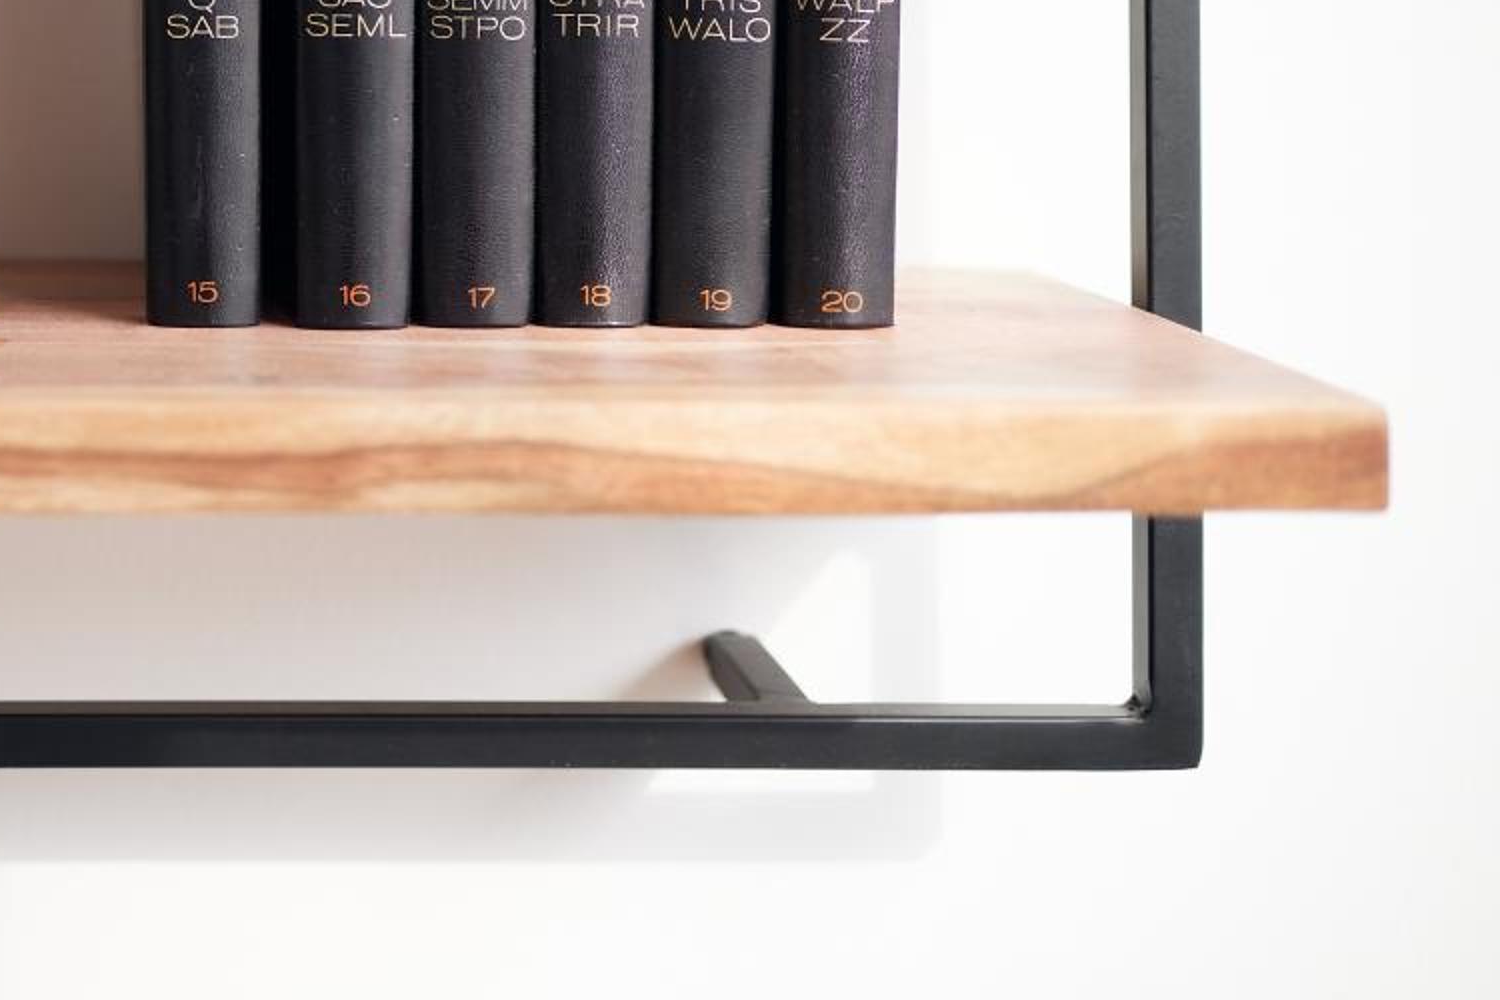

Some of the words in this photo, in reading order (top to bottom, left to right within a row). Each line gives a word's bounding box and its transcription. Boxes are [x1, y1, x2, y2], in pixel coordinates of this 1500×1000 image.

[166, 14, 240, 40] SAB
[306, 12, 408, 38] SEML
[429, 15, 528, 42] STPO
[551, 13, 640, 38] TRIR
[668, 16, 771, 43] WALO
[819, 18, 871, 44] ZZ
[187, 280, 219, 304] 15
[339, 284, 372, 309] 16
[467, 286, 496, 309] 17
[580, 283, 613, 307] 18
[700, 288, 732, 313] 19
[819, 289, 864, 314] 20
